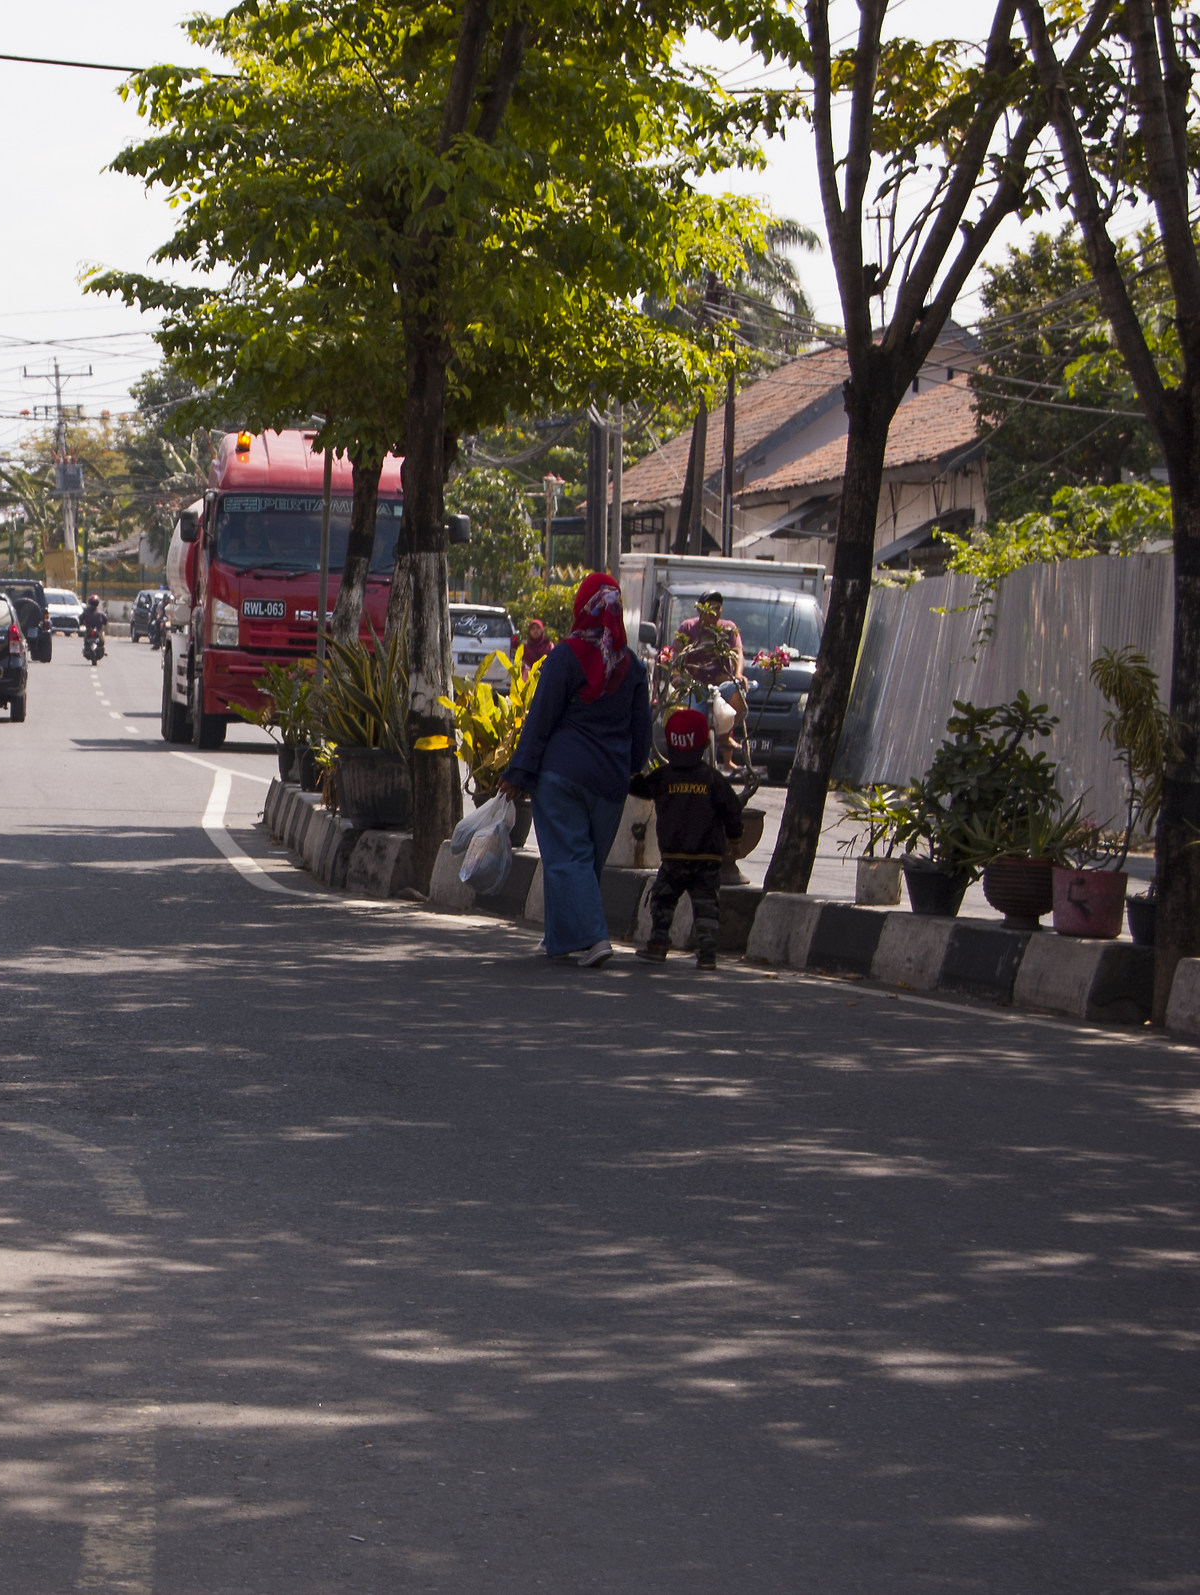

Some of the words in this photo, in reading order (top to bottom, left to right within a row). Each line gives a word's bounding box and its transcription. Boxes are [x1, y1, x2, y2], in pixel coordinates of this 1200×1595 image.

[243, 602, 284, 617] RWL-063
[670, 732, 696, 747] BOY
[668, 783, 708, 795] LIVERPOOL
